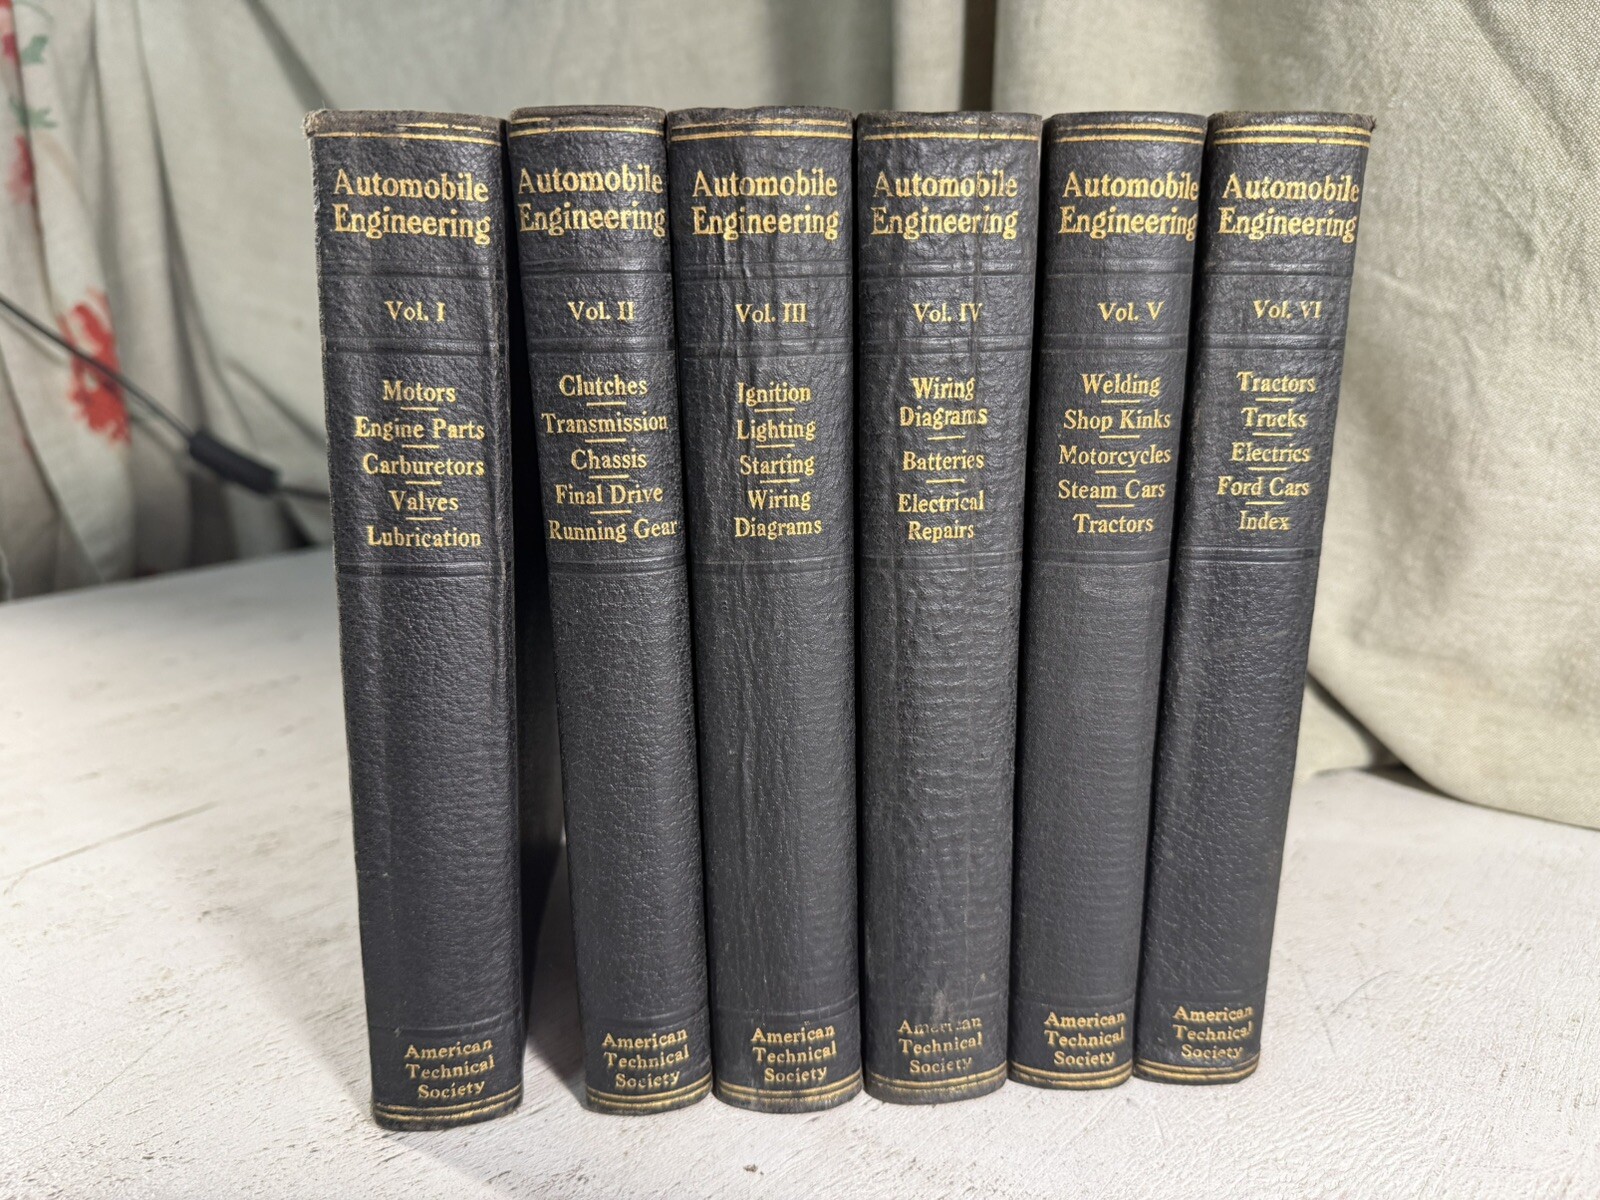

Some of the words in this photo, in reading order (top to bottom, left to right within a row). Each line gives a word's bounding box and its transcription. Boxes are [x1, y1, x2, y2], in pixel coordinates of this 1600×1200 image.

[333, 168, 489, 201] Automobile
[518, 164, 663, 194] Automobile
[692, 168, 838, 198] Automobile
[872, 170, 1018, 198] Automobile
[1062, 171, 1198, 200] Automobile
[1222, 173, 1359, 202] Automobile
[332, 203, 491, 245] Engineering
[519, 201, 666, 237] Engineering
[692, 204, 839, 241] Engineering
[871, 206, 1018, 240] Engineering
[1058, 206, 1198, 241] Engineering
[1218, 206, 1358, 243] Engineering
[385, 301, 429, 321] Vol.
[435, 303, 446, 322] I
[568, 301, 610, 321] Vol.
[617, 301, 635, 320] II
[735, 303, 776, 323] Vol.
[782, 302, 807, 322] III
[913, 303, 952, 322] Vol.
[958, 302, 983, 322] IV
[1098, 302, 1139, 322] Vol.
[1147, 301, 1164, 320] V
[1253, 300, 1292, 319] Vol.
[1299, 300, 1322, 319] VI
[382, 380, 456, 403] Motors
[559, 375, 648, 397] Clutches
[737, 381, 811, 406] Ignition
[911, 377, 976, 401] Wiring
[1081, 373, 1162, 397] Welding
[1237, 371, 1316, 393] Tractors
[354, 415, 424, 441] Engine
[432, 417, 485, 440] Parts
[541, 411, 668, 434] Transmission
[900, 406, 988, 430] Diagrams
[1063, 409, 1113, 433] Shop
[1119, 409, 1172, 430] Kinks
[1241, 407, 1307, 428] Trucks
[736, 419, 816, 443] Lighting
[571, 448, 647, 471] Chassis
[902, 450, 985, 471] Batteries
[1058, 444, 1172, 467] Motorcycles
[1229, 441, 1311, 463] Electrics
[362, 453, 485, 476] Carburetors
[740, 453, 815, 476] Starting
[555, 484, 603, 506] Final
[609, 485, 663, 504] Drive
[1058, 481, 1117, 500] Steam
[1125, 479, 1165, 498] Cars
[1217, 475, 1264, 497] Ford
[1269, 477, 1310, 496] Cars
[388, 490, 459, 512] Valves
[748, 490, 812, 512] Wiring
[897, 491, 985, 513] Electrical
[549, 520, 627, 542] Running
[634, 519, 678, 539] Gear
[734, 516, 822, 539] Diagrams
[908, 520, 974, 544] Repairs
[1072, 513, 1154, 534] Tractors
[1238, 510, 1290, 531] Index
[366, 525, 482, 548] Lubrication
[1044, 1011, 1126, 1029] American
[1173, 1006, 1253, 1023] American
[602, 1029, 688, 1050] American
[751, 1025, 835, 1044] American
[1044, 1027, 1125, 1048] Technical
[1172, 1021, 1253, 1041] Technical
[405, 1038, 493, 1060] American
[752, 1041, 837, 1064] Technical
[898, 1032, 983, 1055] Technical
[1181, 1044, 1243, 1060] Society
[406, 1055, 495, 1080] Technical
[603, 1046, 690, 1069] Technical
[910, 1056, 973, 1074] Society
[1053, 1050, 1116, 1067] Society
[615, 1069, 680, 1089] Society
[764, 1066, 828, 1083] Society
[418, 1079, 486, 1100] Society
